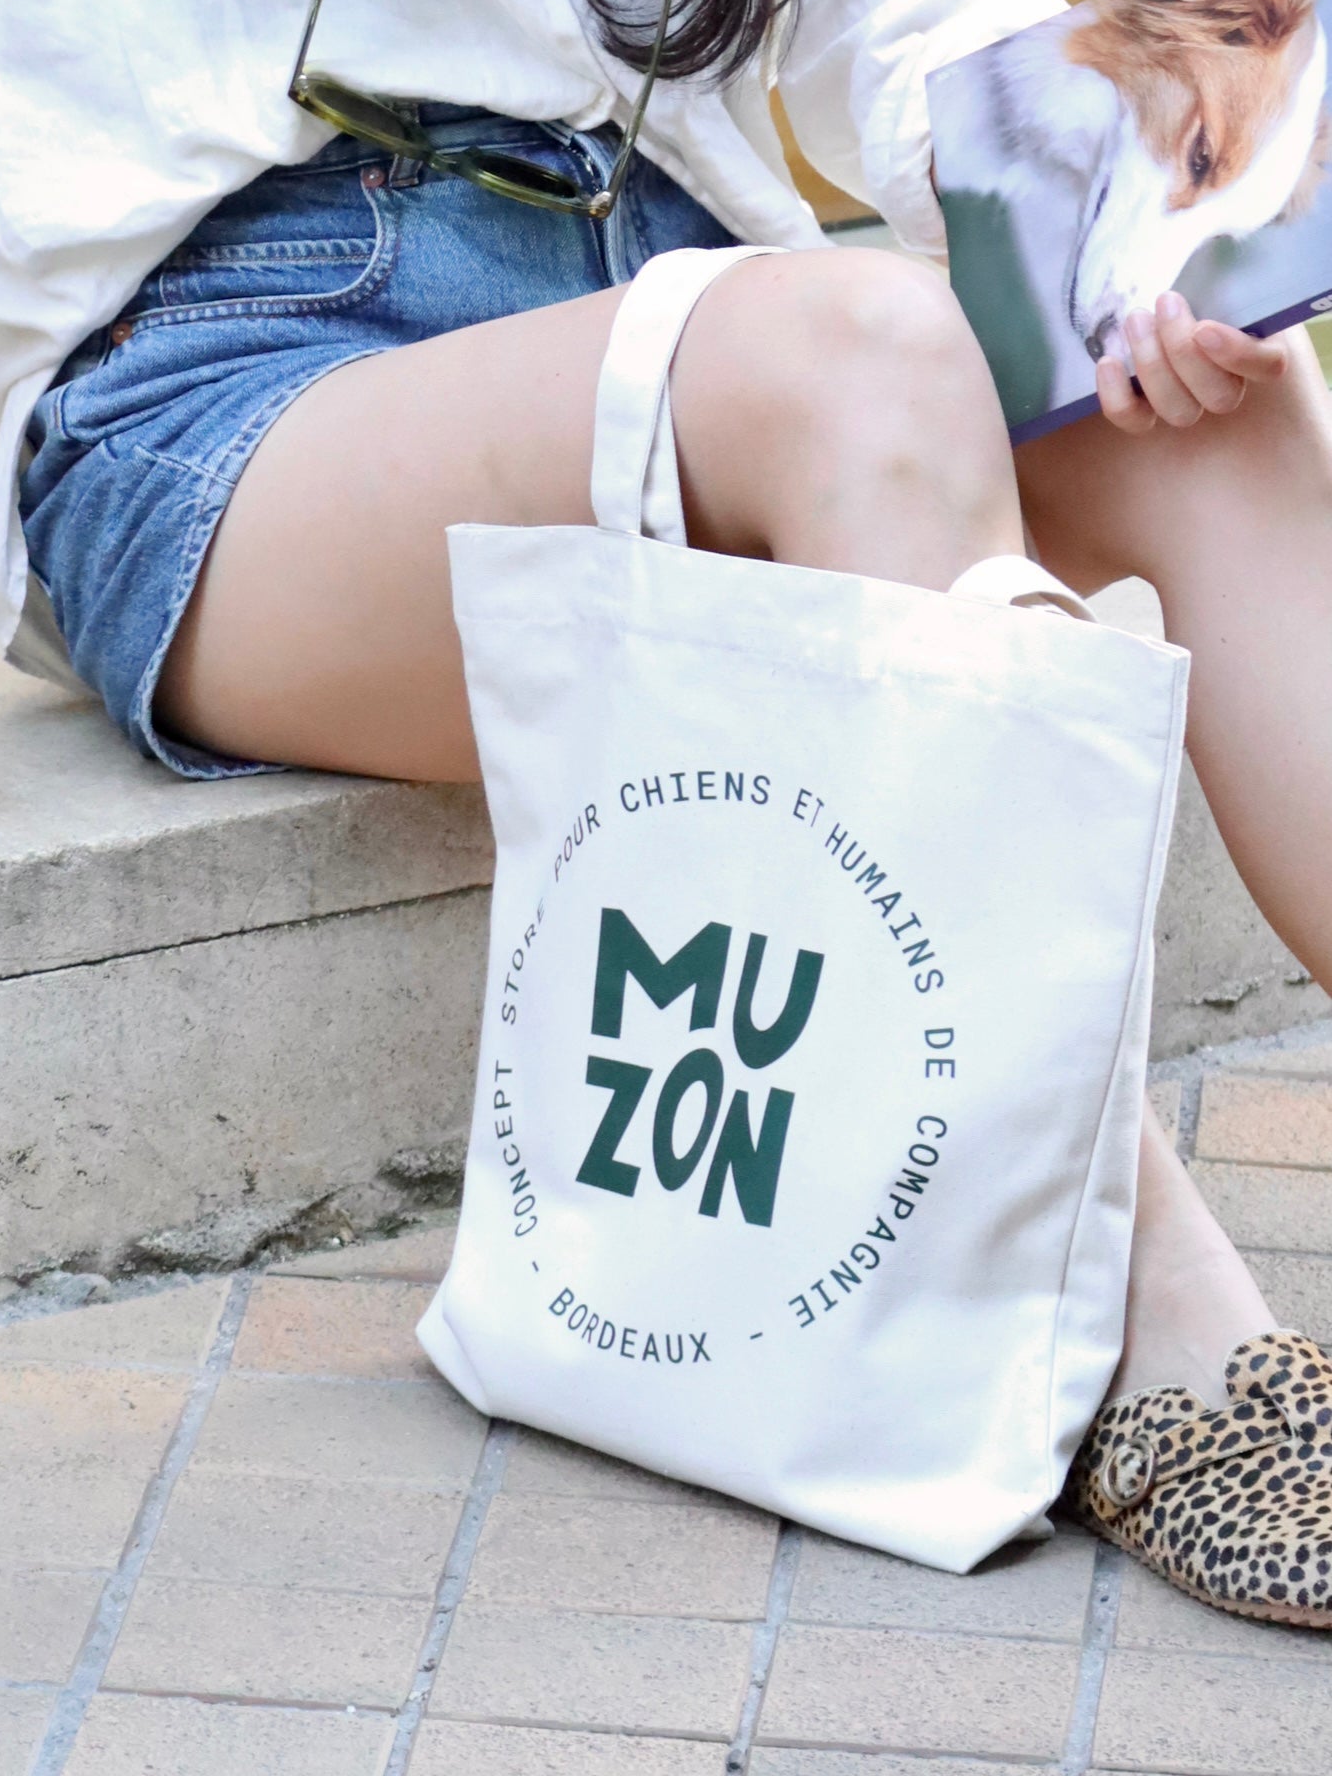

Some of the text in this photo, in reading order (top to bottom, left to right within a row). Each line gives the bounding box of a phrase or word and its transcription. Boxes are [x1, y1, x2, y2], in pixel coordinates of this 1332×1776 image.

[553, 803, 601, 883] POUR
[619, 770, 772, 813] CHIENS
[792, 787, 825, 828] ET
[501, 897, 546, 1026] STORE
[824, 822, 945, 994] HUMAINS
[590, 906, 826, 1070] MU
[924, 1027, 956, 1079] DE
[493, 1059, 538, 1238] CONCEPT
[574, 1047, 796, 1228] ZON
[788, 1115, 948, 1329] COMPAGNIE
[548, 1286, 712, 1364] BORDEAUX
